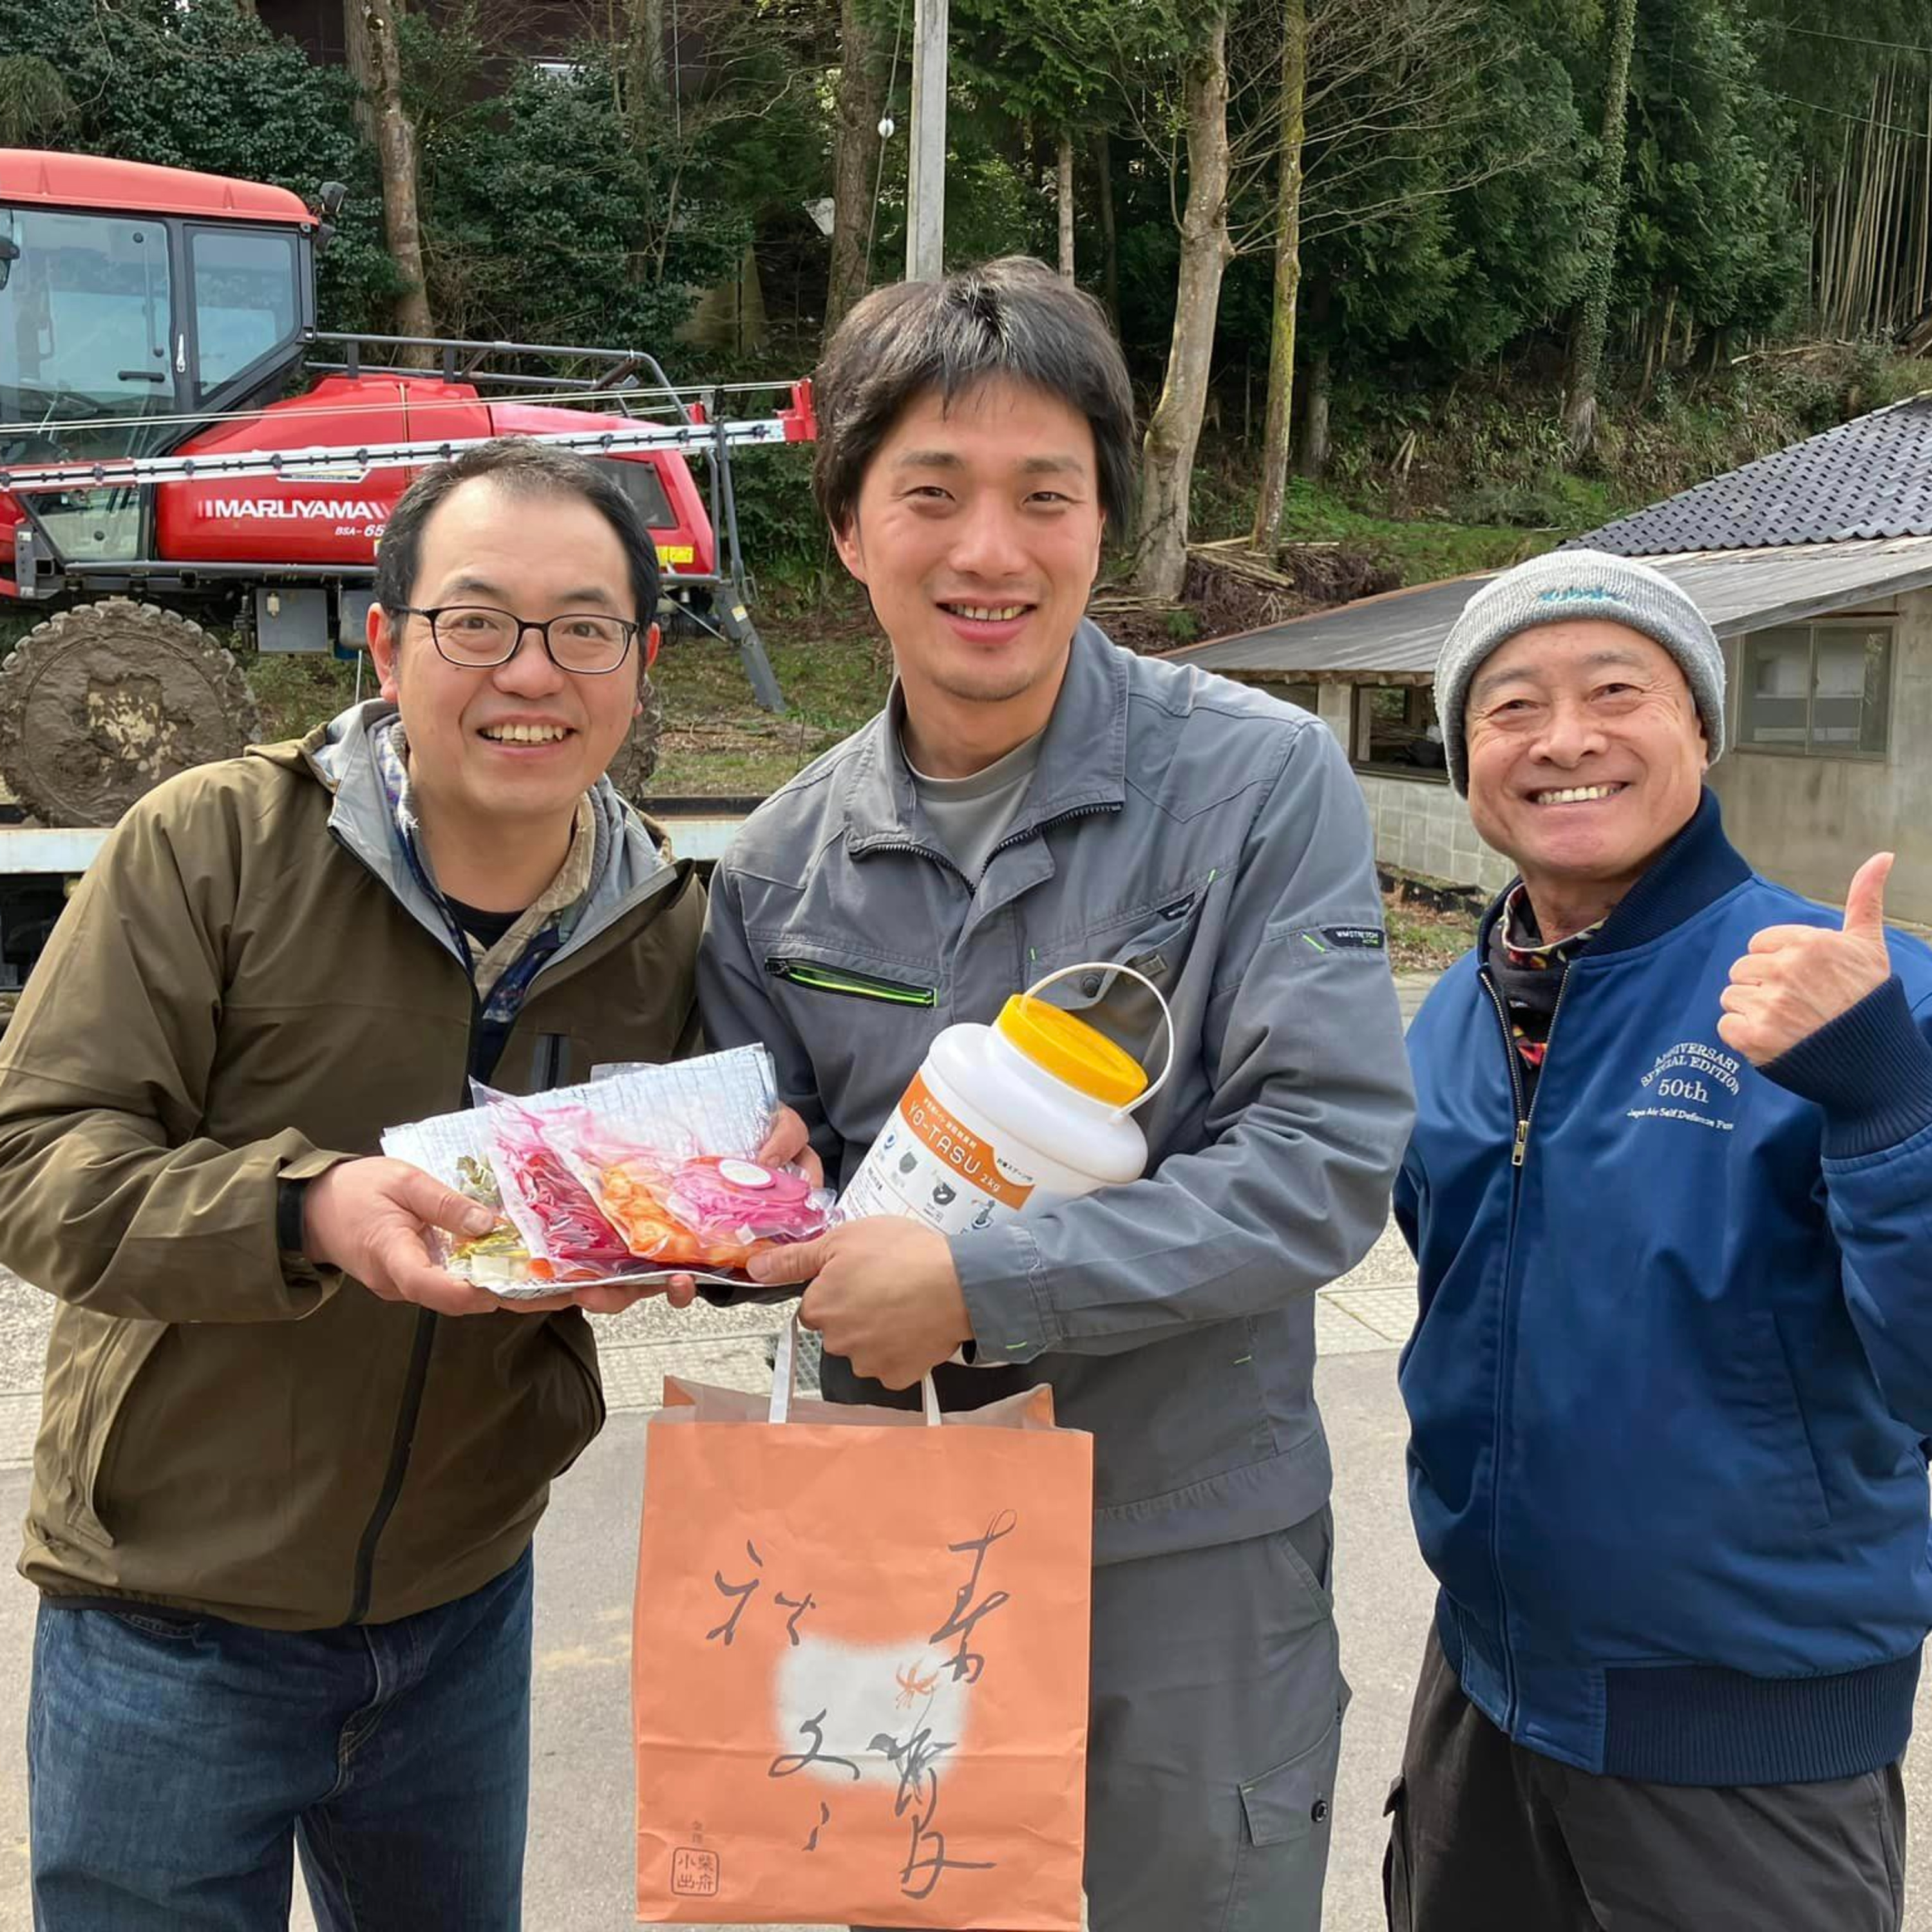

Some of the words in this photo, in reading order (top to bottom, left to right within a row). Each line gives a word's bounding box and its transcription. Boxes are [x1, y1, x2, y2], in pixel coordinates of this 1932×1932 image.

[215, 499, 374, 518] MARUYAMA
[1658, 1078, 1709, 1104] 50th
[1689, 1056, 1740, 1095] EDITION
[908, 1100, 981, 1174] YO-TASU
[980, 1174, 1001, 1191] 2kg
